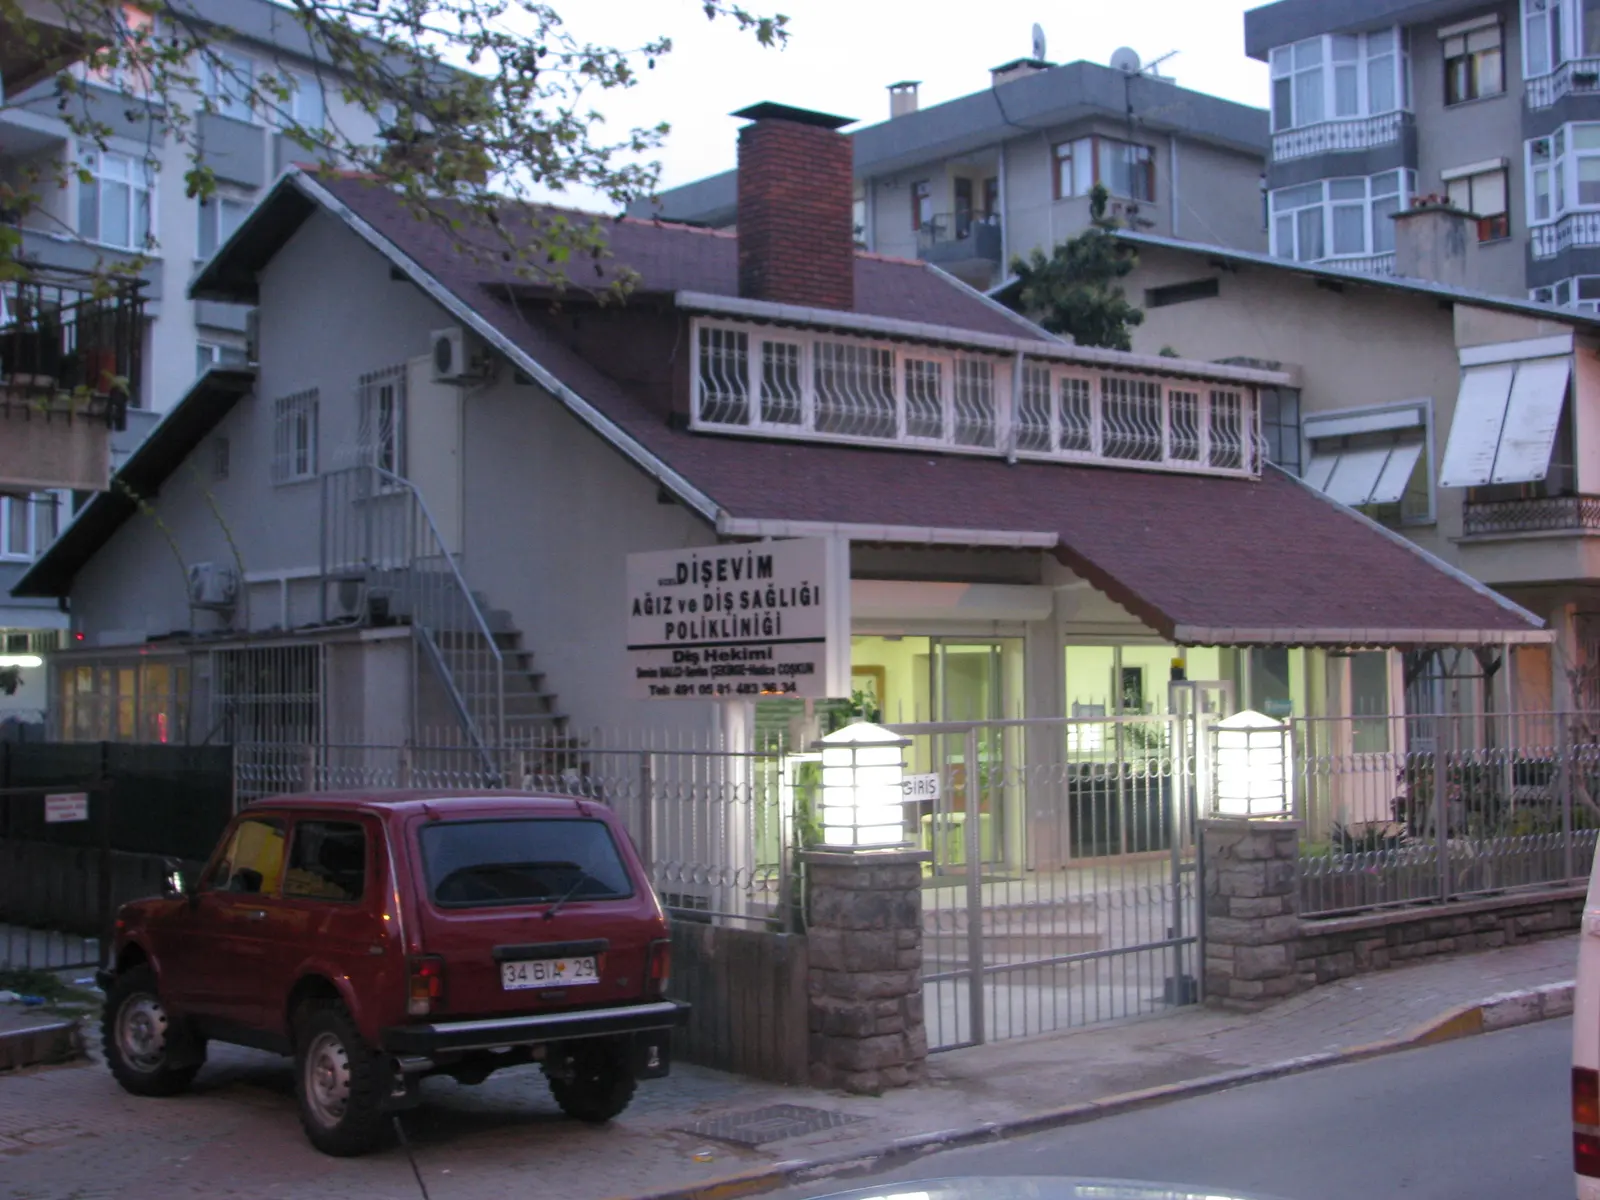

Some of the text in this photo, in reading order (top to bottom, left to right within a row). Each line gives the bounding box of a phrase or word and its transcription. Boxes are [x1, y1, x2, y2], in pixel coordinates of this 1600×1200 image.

[632, 581, 820, 617] AĞIZ ve DİŞ SAĞLIĞI
[665, 612, 781, 641] POLİKLİNİĞİ
[672, 646, 773, 665] Diş Hekimi
[506, 964, 527, 982] 34
